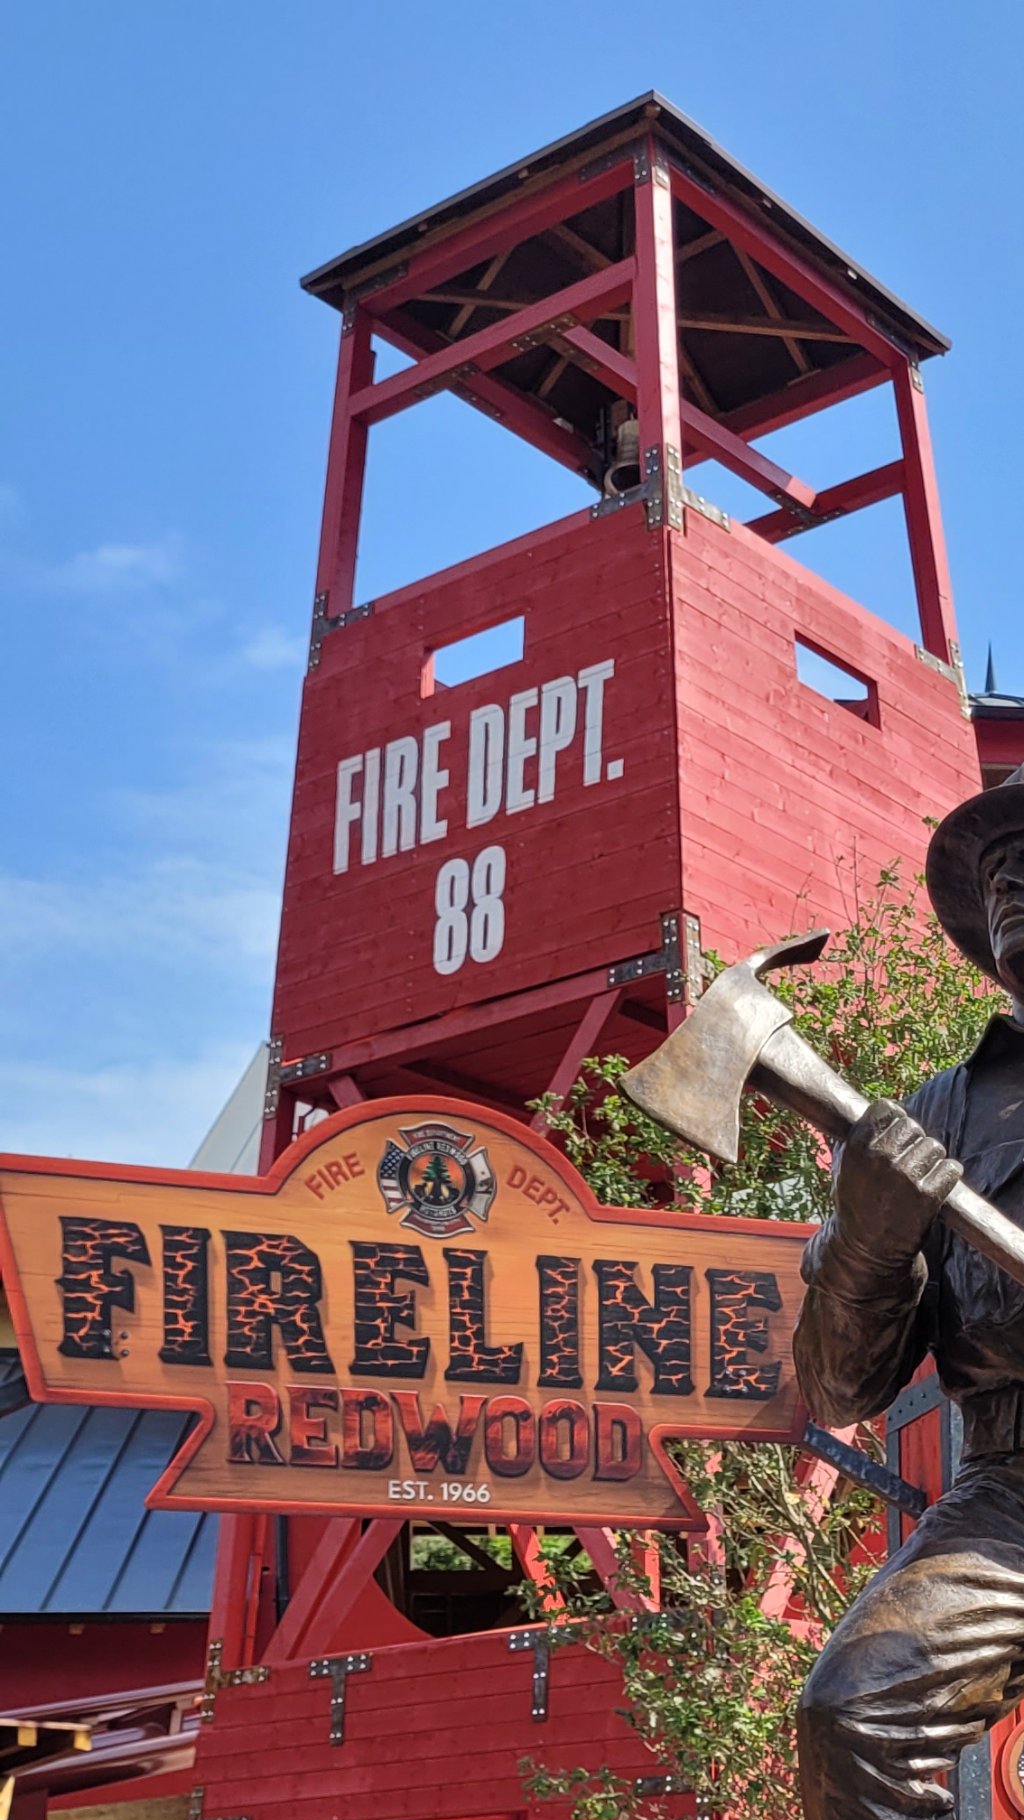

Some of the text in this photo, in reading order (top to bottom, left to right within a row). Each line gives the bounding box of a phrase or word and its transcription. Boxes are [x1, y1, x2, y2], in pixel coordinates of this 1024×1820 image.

[333, 658, 624, 875] FIRE DEPT.
[433, 845, 507, 975] 88
[304, 1152, 571, 1224] FIRE DEPT.
[55, 1215, 784, 1398] FIRELINE
[226, 1381, 644, 1481] REDWOOD
[388, 1479, 491, 1503] EST. 1966
